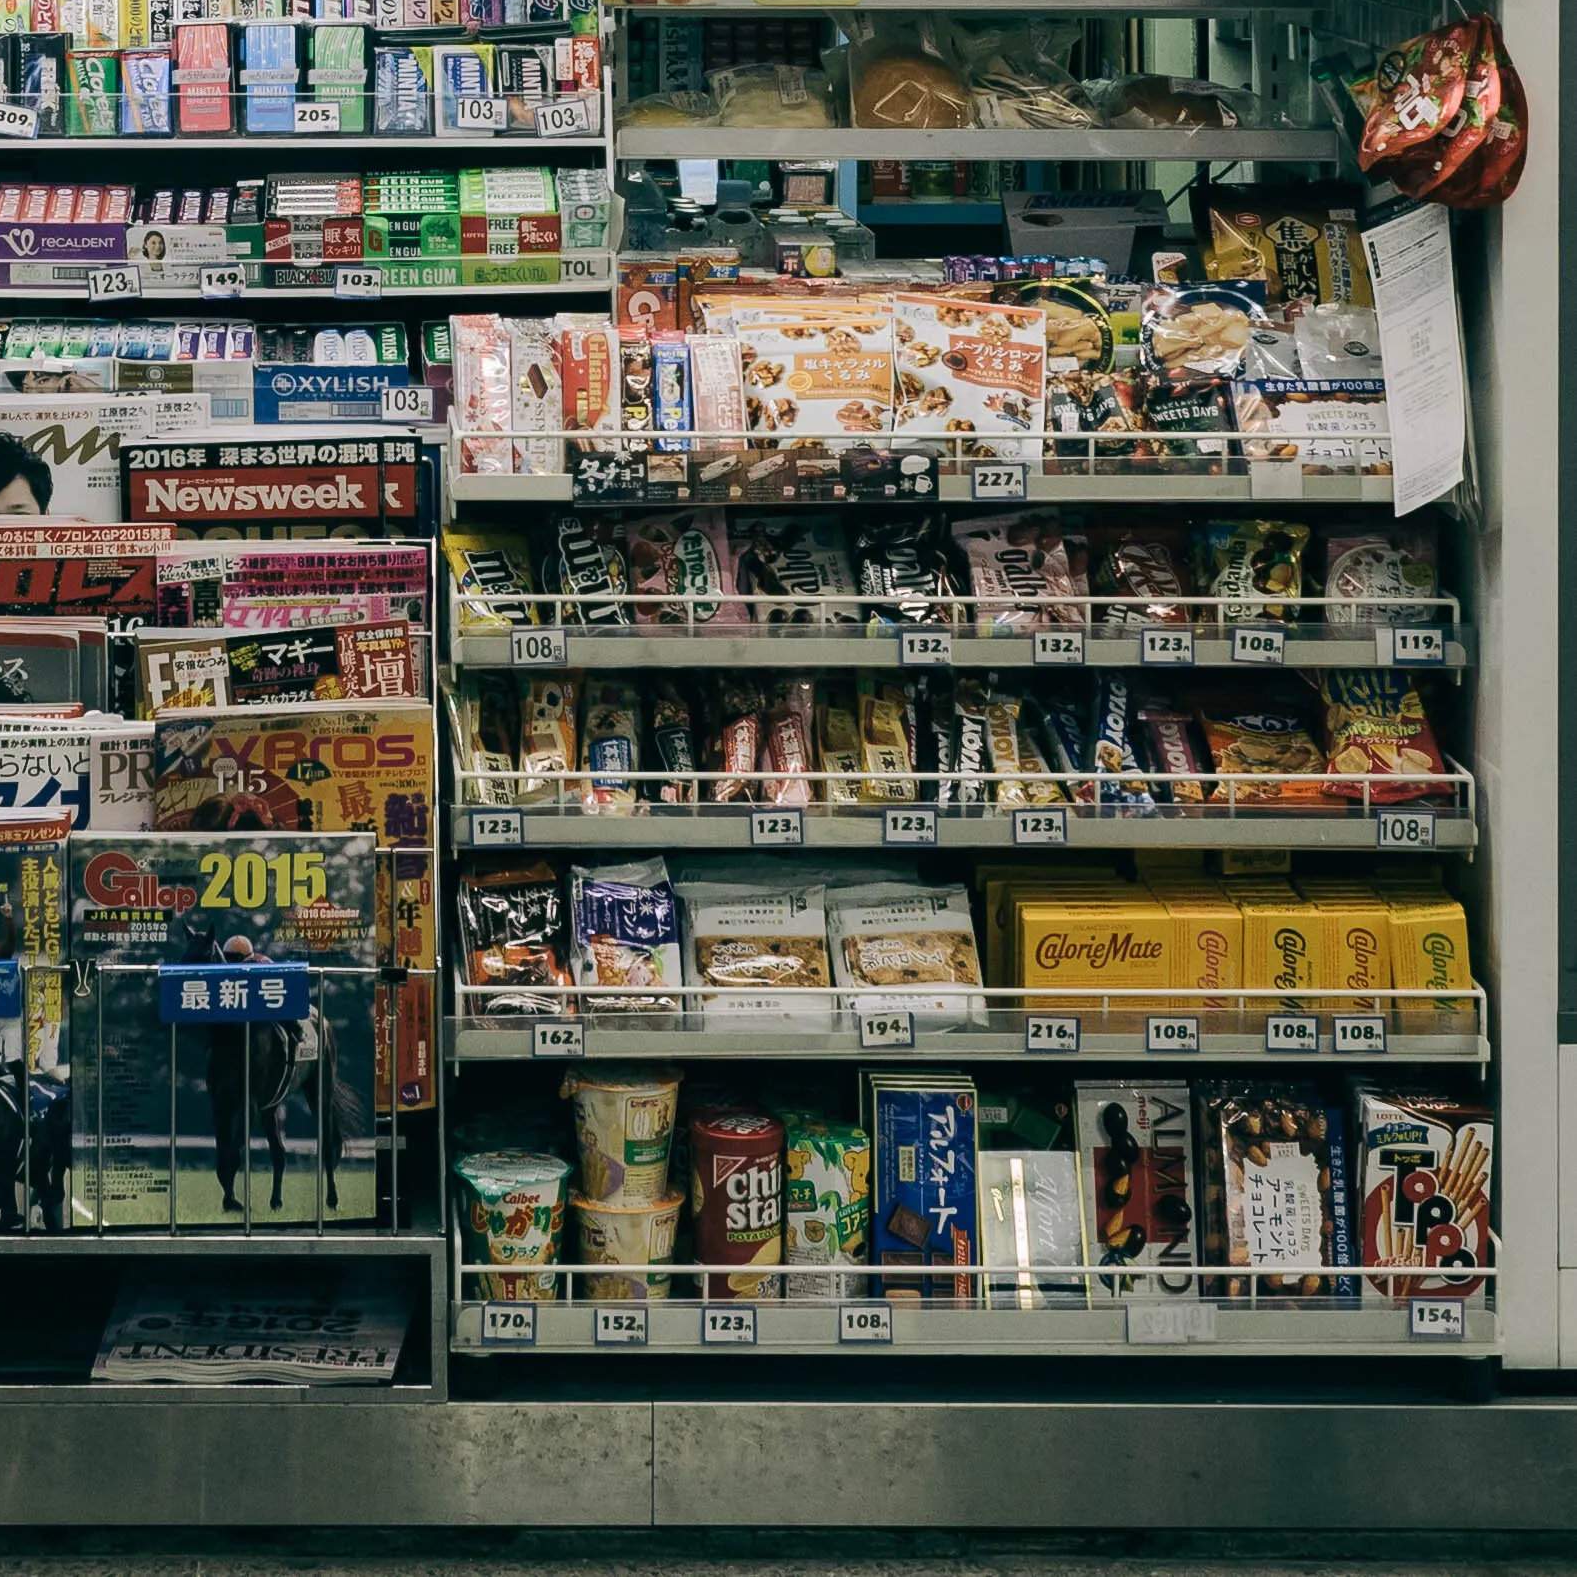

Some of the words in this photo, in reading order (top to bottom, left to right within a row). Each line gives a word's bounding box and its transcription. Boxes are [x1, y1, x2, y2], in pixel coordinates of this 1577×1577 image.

[297, 375, 390, 393] XYLISH
[129, 446, 207, 469] 2016年
[220, 444, 378, 466] 深まる世界の混沌
[145, 479, 365, 513] Newsweek
[199, 853, 328, 908] 2015
[181, 978, 287, 1010] 最新号
[1376, 1113, 1405, 1121] LOTTE
[1269, 1178, 1285, 1258] アーモンド
